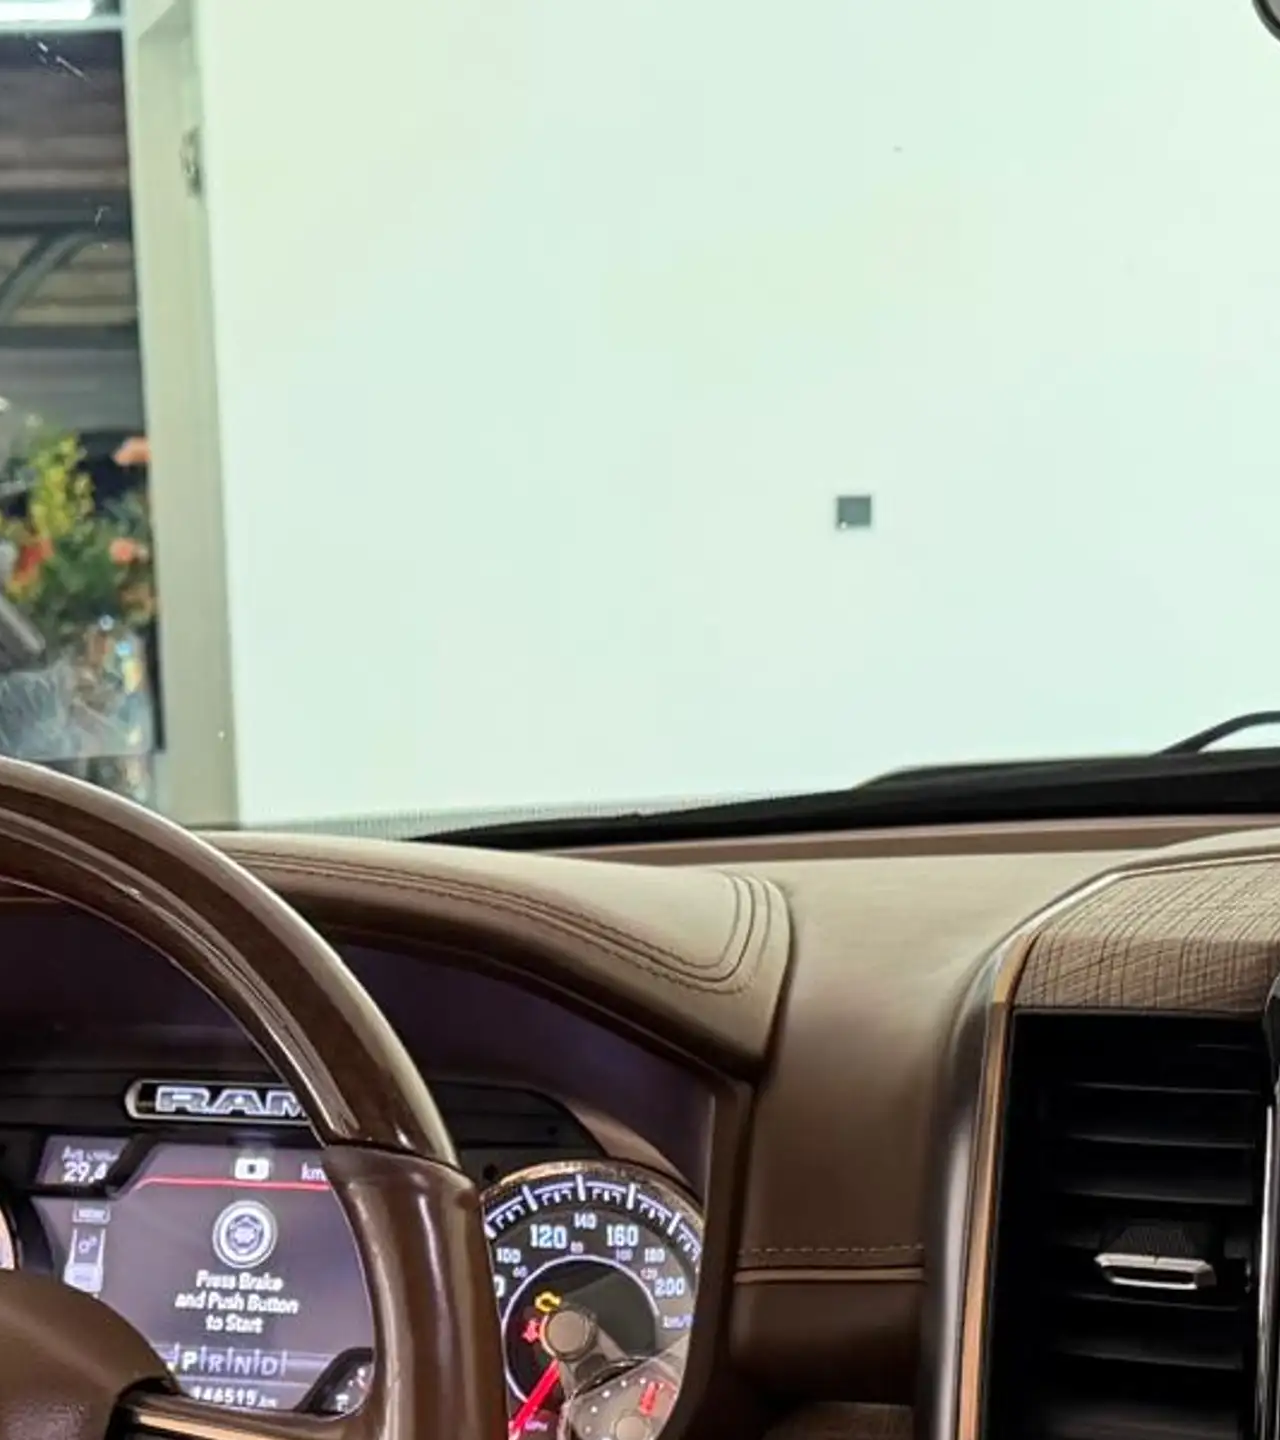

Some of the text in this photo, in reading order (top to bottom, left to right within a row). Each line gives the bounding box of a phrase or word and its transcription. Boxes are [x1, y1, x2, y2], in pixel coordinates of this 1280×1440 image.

[155, 1085, 308, 1117] RAM
[530, 1223, 568, 1249] 120
[606, 1224, 639, 1247] 160
[654, 1277, 686, 1297] 200
